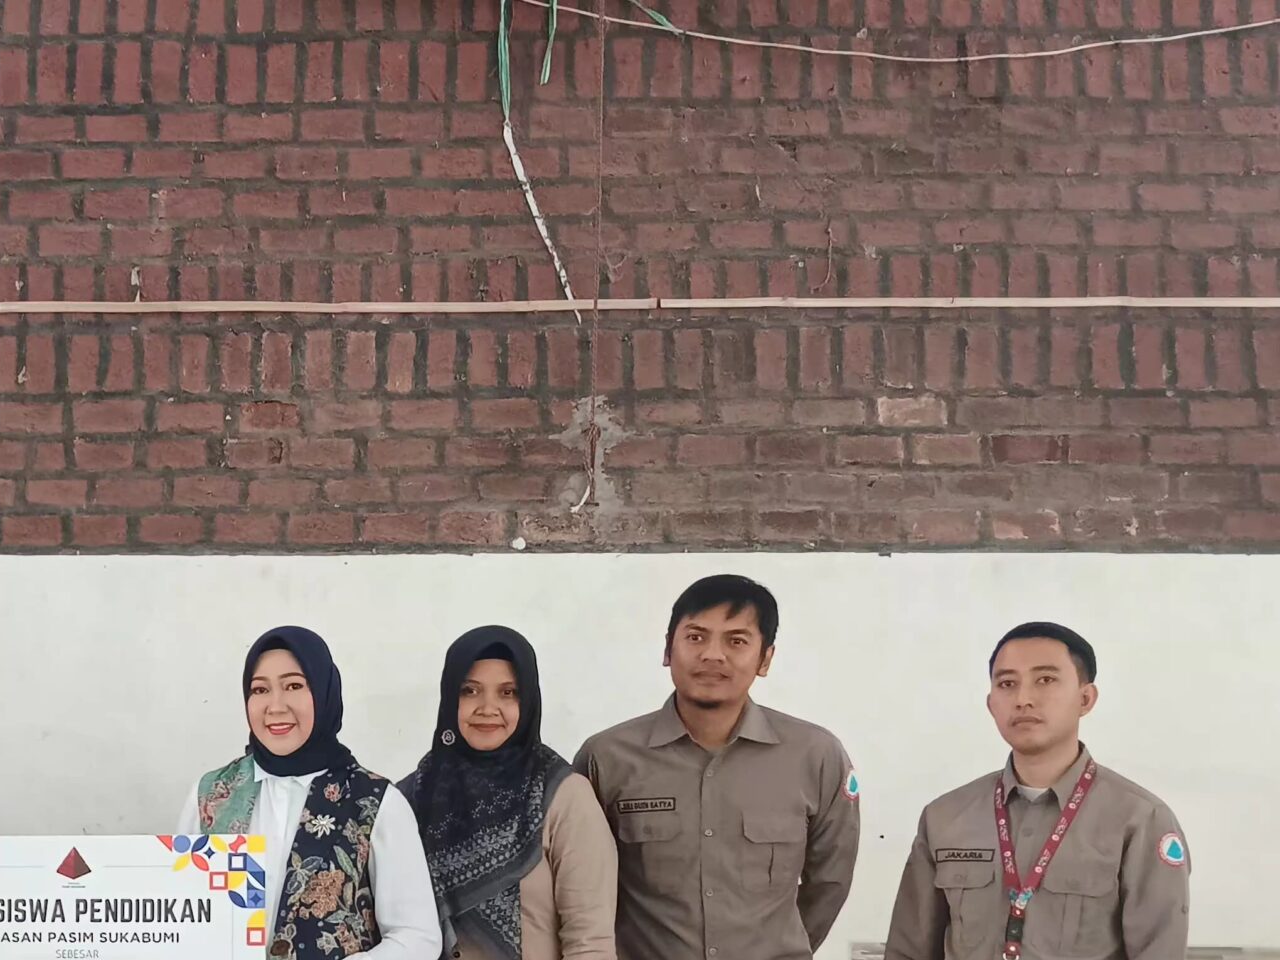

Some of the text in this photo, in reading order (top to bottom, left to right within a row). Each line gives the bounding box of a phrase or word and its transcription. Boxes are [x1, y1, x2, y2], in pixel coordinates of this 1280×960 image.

[75, 897, 212, 924] PENDIDIKAN
[47, 931, 94, 944] PASIM
[99, 931, 180, 944] SUKABUMI
[55, 949, 99, 960] SEBESAR
